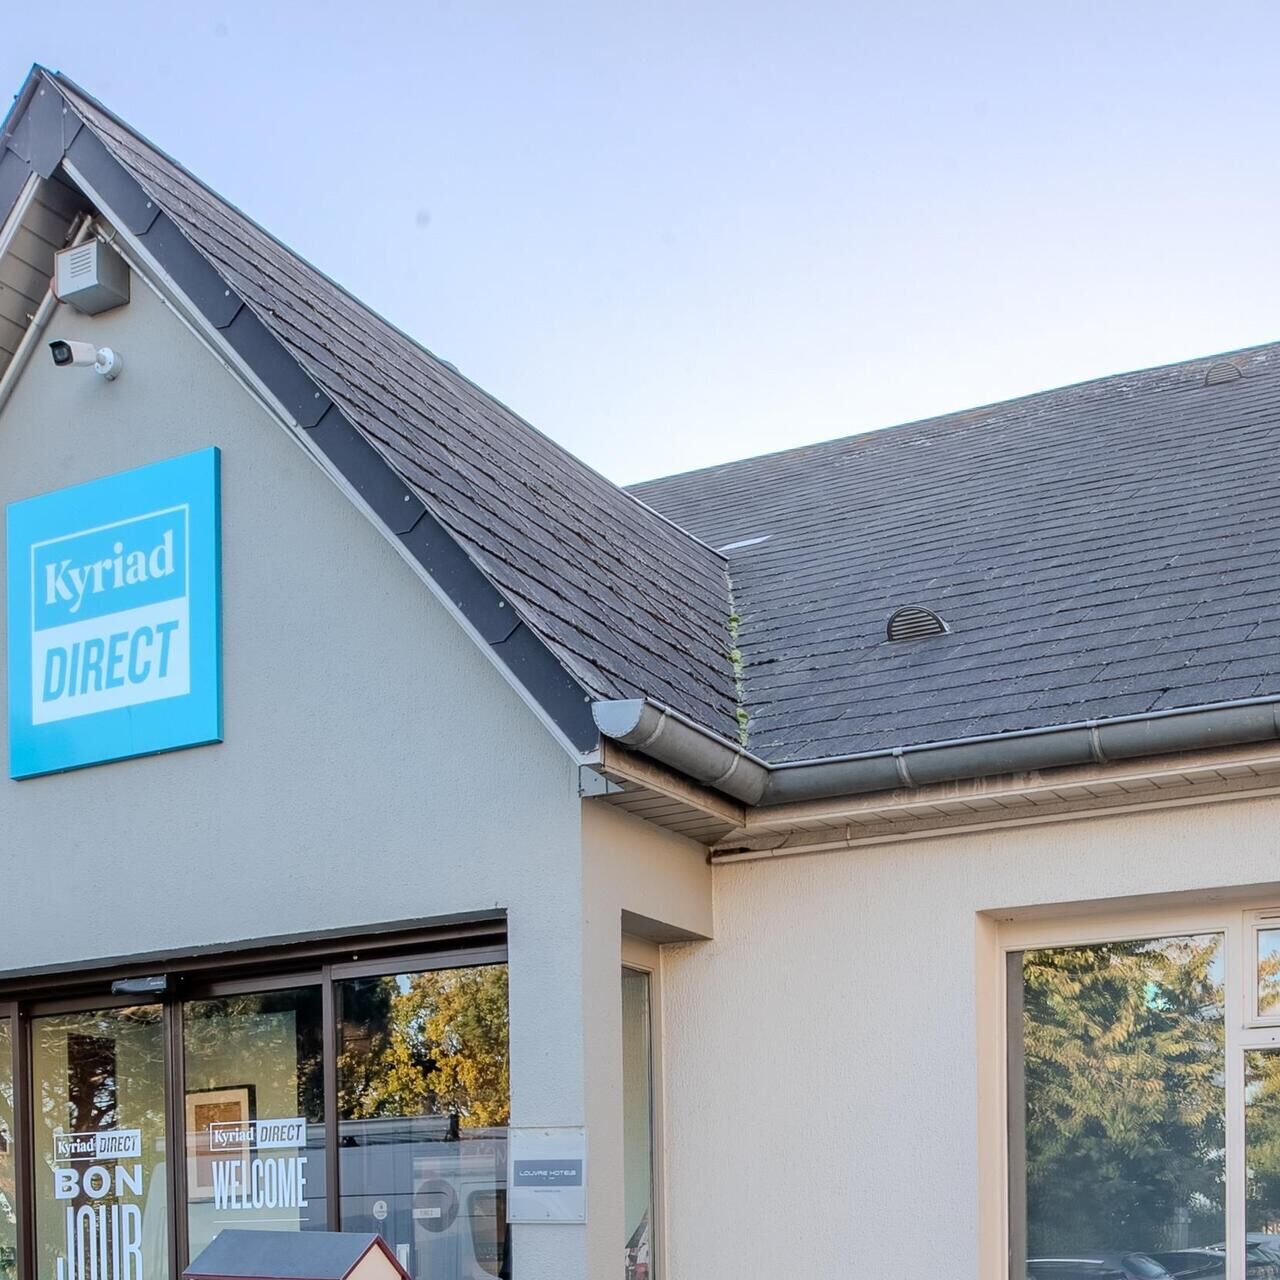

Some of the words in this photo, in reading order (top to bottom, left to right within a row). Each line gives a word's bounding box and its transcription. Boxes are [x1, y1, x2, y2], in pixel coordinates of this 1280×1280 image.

[45, 529, 175, 614] Kyriad
[42, 620, 180, 703] DIRECT
[57, 1137, 95, 1158] Kyriad
[99, 1135, 138, 1153] DIRECT
[214, 1126, 255, 1147] Kyriad
[260, 1124, 303, 1143] DIRECT
[54, 1164, 143, 1200] BON
[211, 1157, 309, 1210] WELCOME
